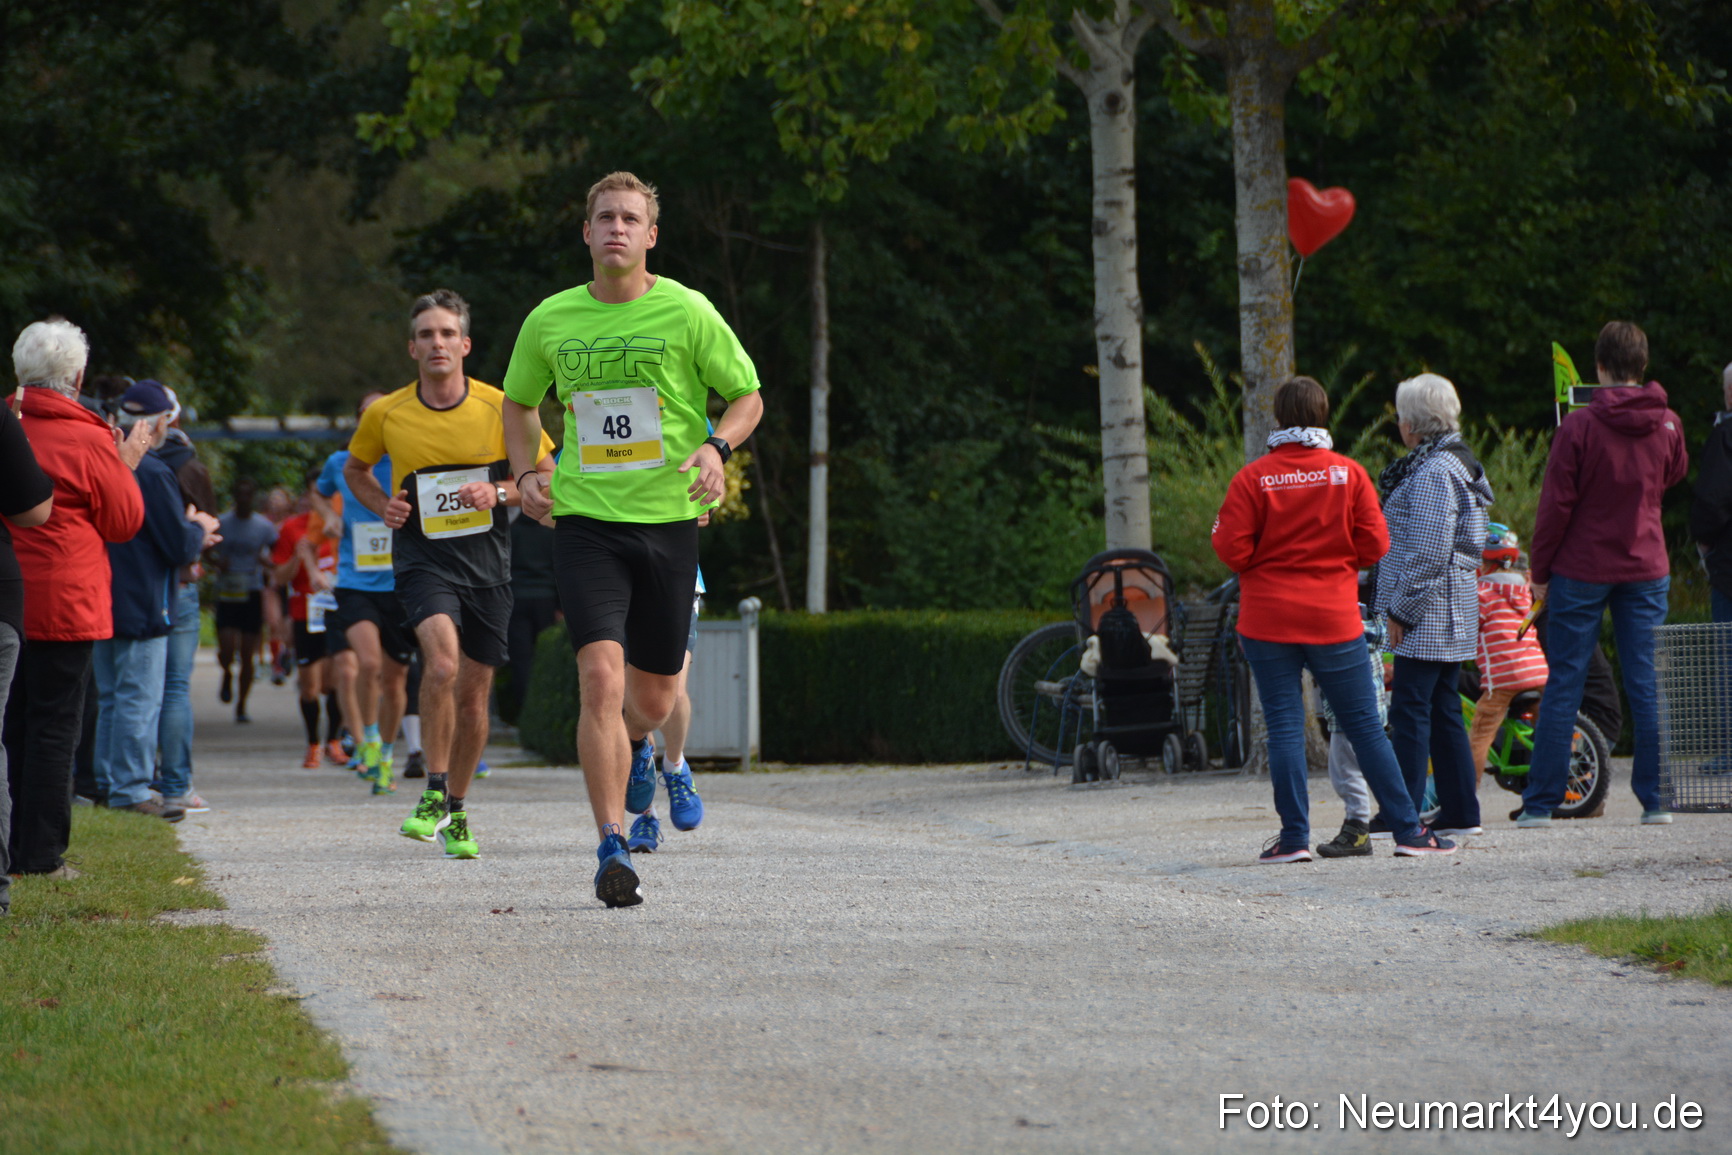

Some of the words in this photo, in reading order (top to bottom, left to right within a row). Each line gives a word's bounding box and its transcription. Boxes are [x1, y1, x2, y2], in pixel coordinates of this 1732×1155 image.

[602, 414, 632, 440] 48
[606, 448, 633, 458] Marco
[1260, 469, 1327, 487] raumbox
[445, 516, 470, 527] Florian
[369, 537, 388, 552] 97
